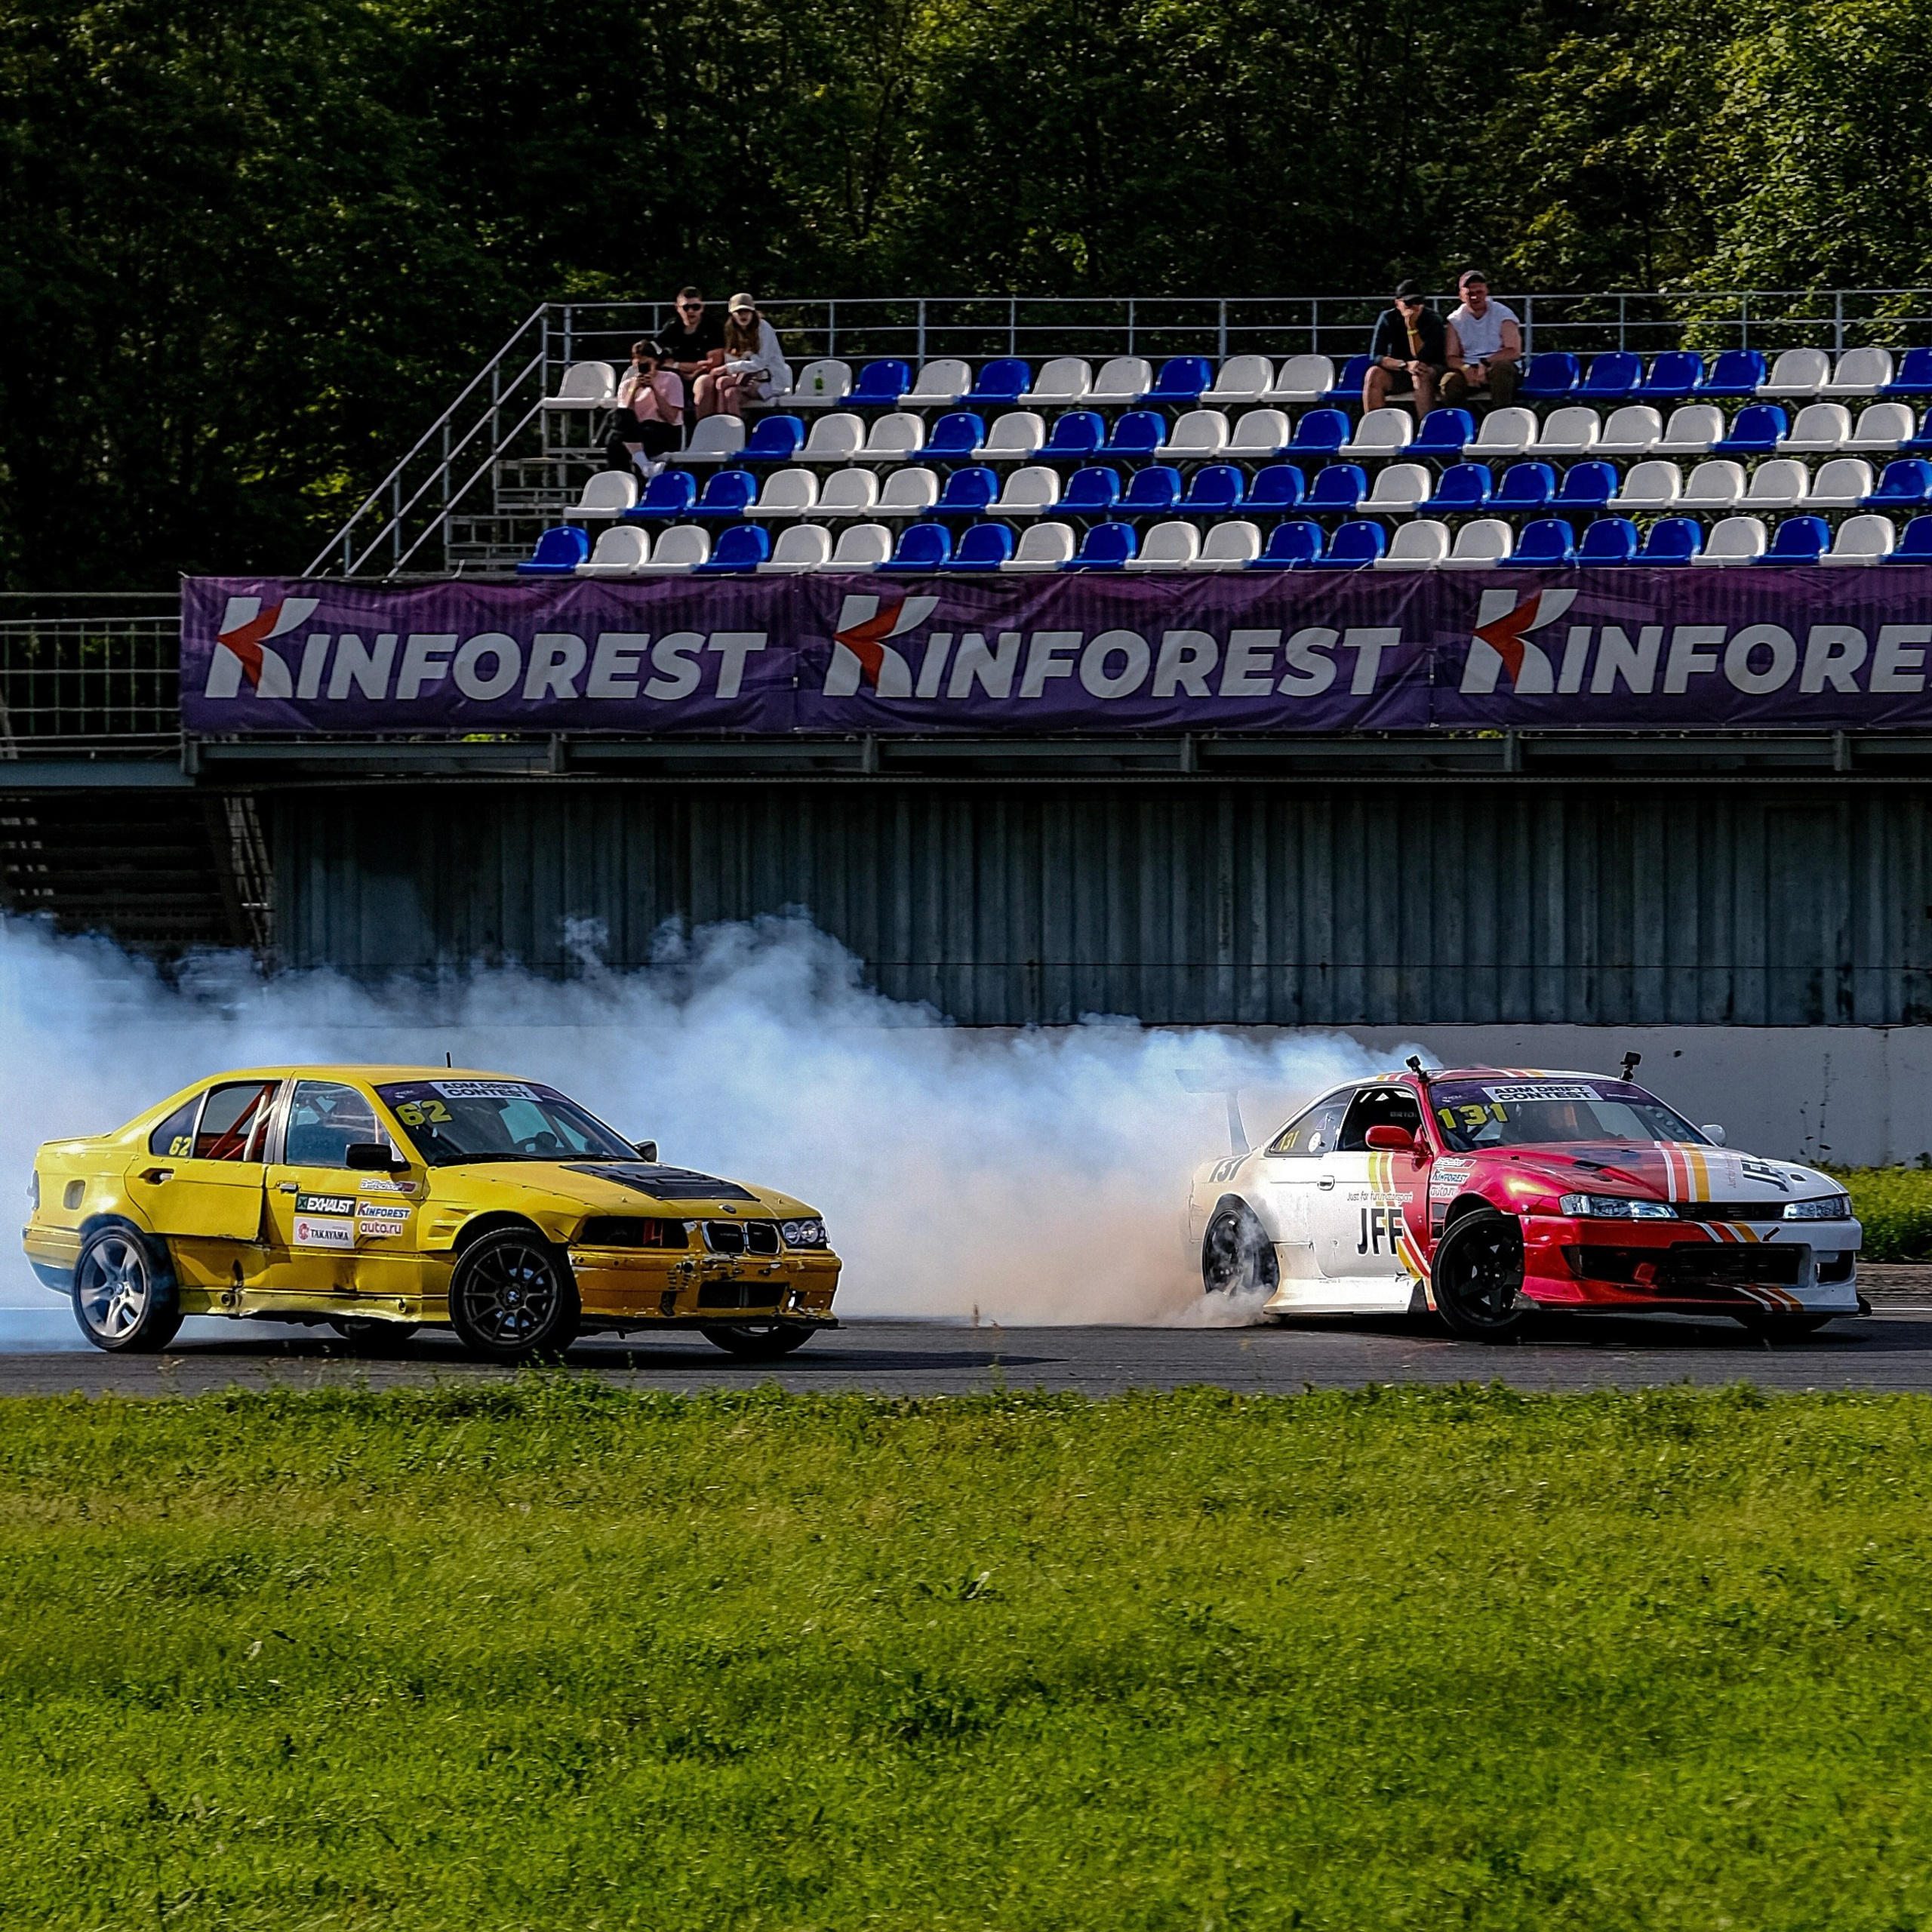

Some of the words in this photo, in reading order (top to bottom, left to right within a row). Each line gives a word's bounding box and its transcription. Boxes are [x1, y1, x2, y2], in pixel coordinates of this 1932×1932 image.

[204, 597, 767, 700] KINFOREST
[823, 595, 1401, 699] KINFOREST
[1459, 589, 1932, 694] KINFORE
[447, 1089, 531, 1098] CONTEST
[1498, 1091, 1591, 1100] CONTEST
[395, 1100, 452, 1126] 62
[1437, 1103, 1508, 1129] 131
[169, 1136, 192, 1155] 62
[1279, 1131, 1300, 1151] 131
[307, 1197, 355, 1214] EXHAUST
[357, 1203, 410, 1218] KINFOREST
[310, 1229, 349, 1240] TAKAYAMA
[361, 1222, 401, 1234] auto.ru
[1357, 1208, 1403, 1254] JFF
